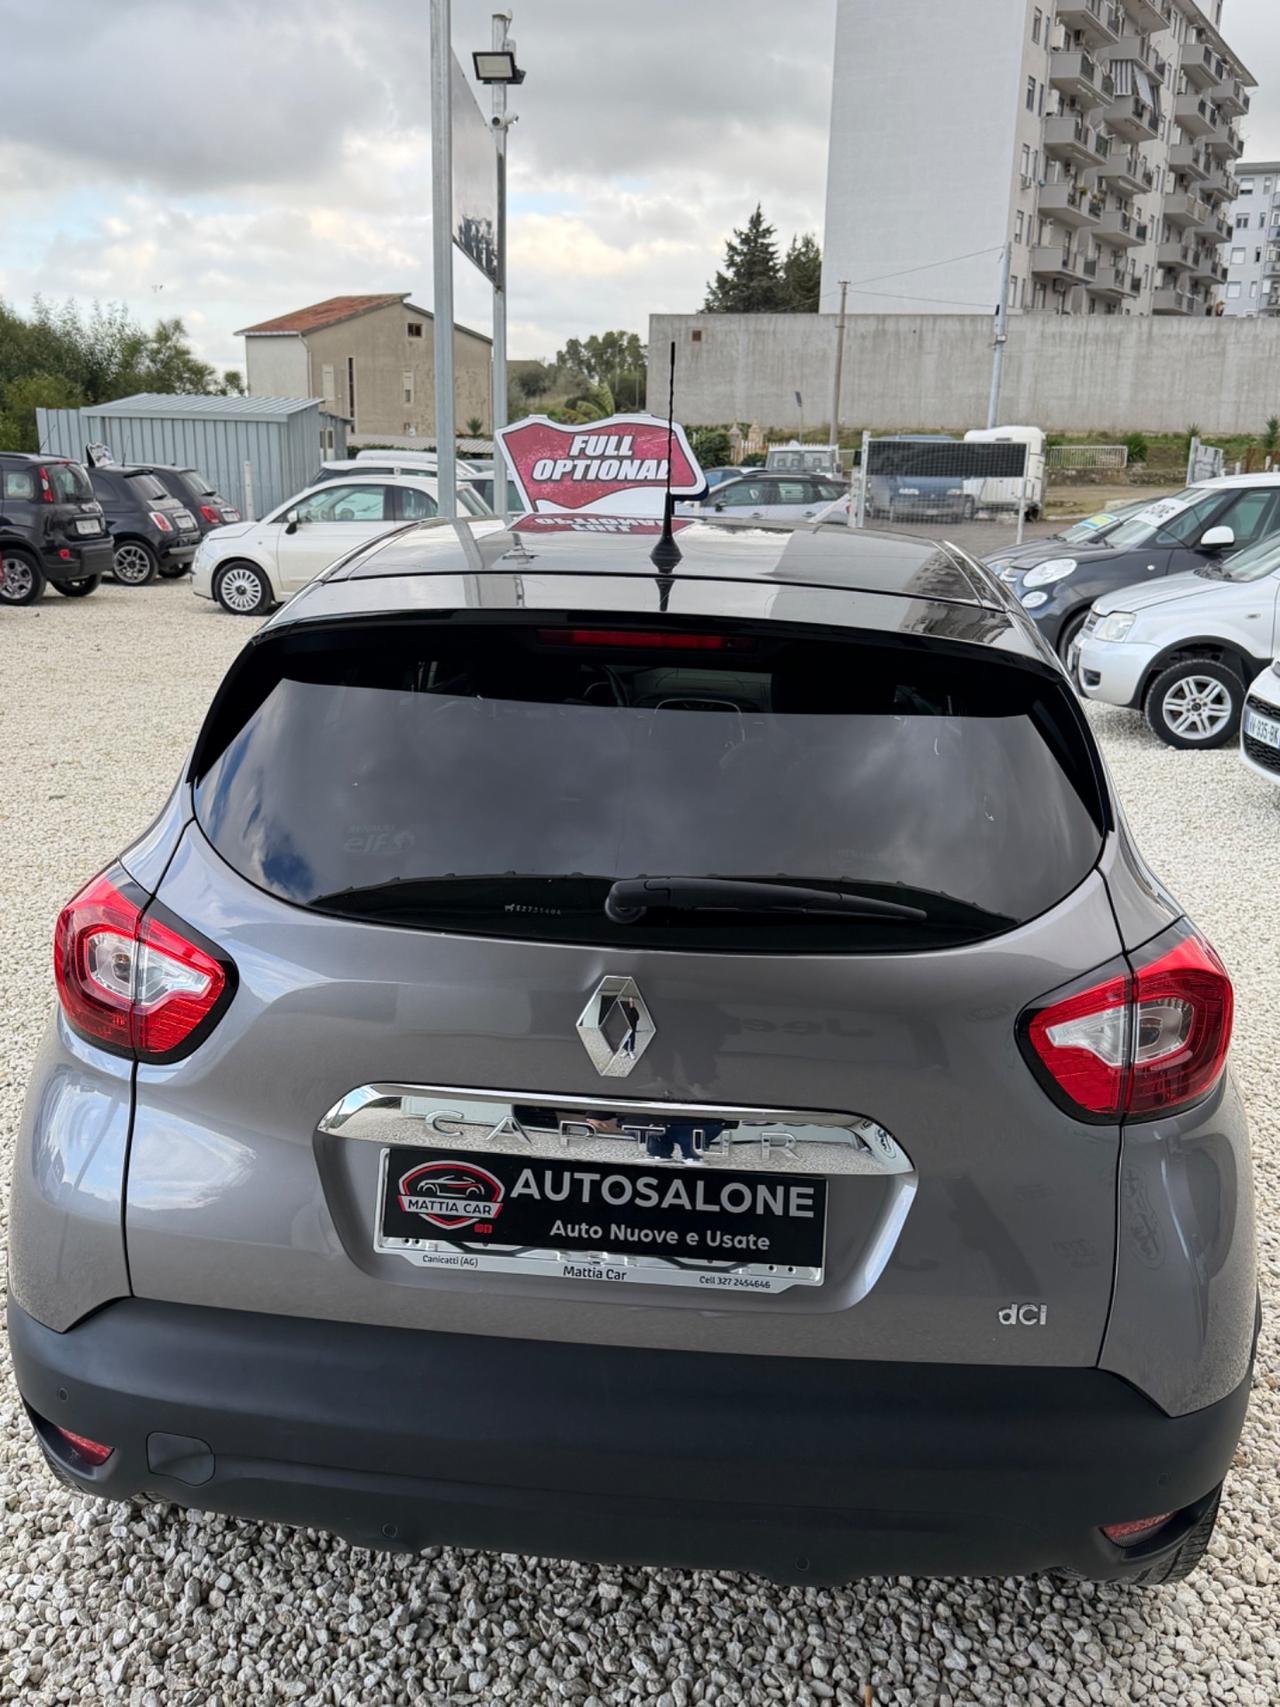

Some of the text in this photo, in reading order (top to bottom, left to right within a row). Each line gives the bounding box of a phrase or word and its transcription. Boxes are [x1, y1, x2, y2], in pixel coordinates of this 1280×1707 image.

[570, 435, 633, 457] FULL
[532, 459, 668, 481] OPTIONAL
[424, 1110, 801, 1161] CAPTUR
[510, 1168, 815, 1218] AUTOSALONE
[408, 1200, 493, 1216] MATTIA CAR
[550, 1219, 770, 1251] Auto Nuove e Usate
[458, 1257, 478, 1268] (AG)
[563, 1265, 627, 1281] Mattia Car
[699, 1275, 715, 1285] Cell
[717, 1276, 733, 1286] 327
